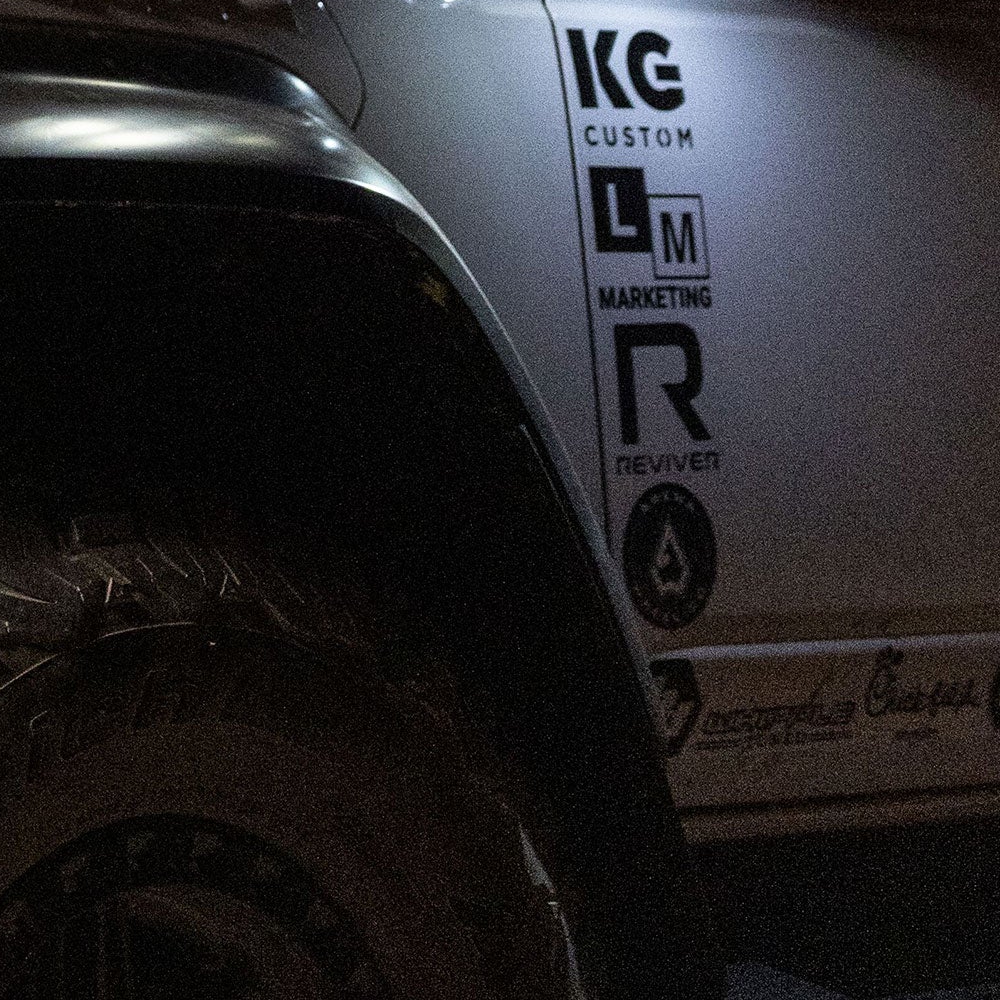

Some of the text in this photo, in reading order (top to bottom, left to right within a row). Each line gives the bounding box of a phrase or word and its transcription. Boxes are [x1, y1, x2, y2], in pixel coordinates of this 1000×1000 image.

[566, 28, 685, 111] KG
[584, 125, 693, 149] CUSTOM
[600, 286, 712, 310] MARKETING
[614, 323, 711, 445] R
[616, 452, 720, 475] REVIVER
